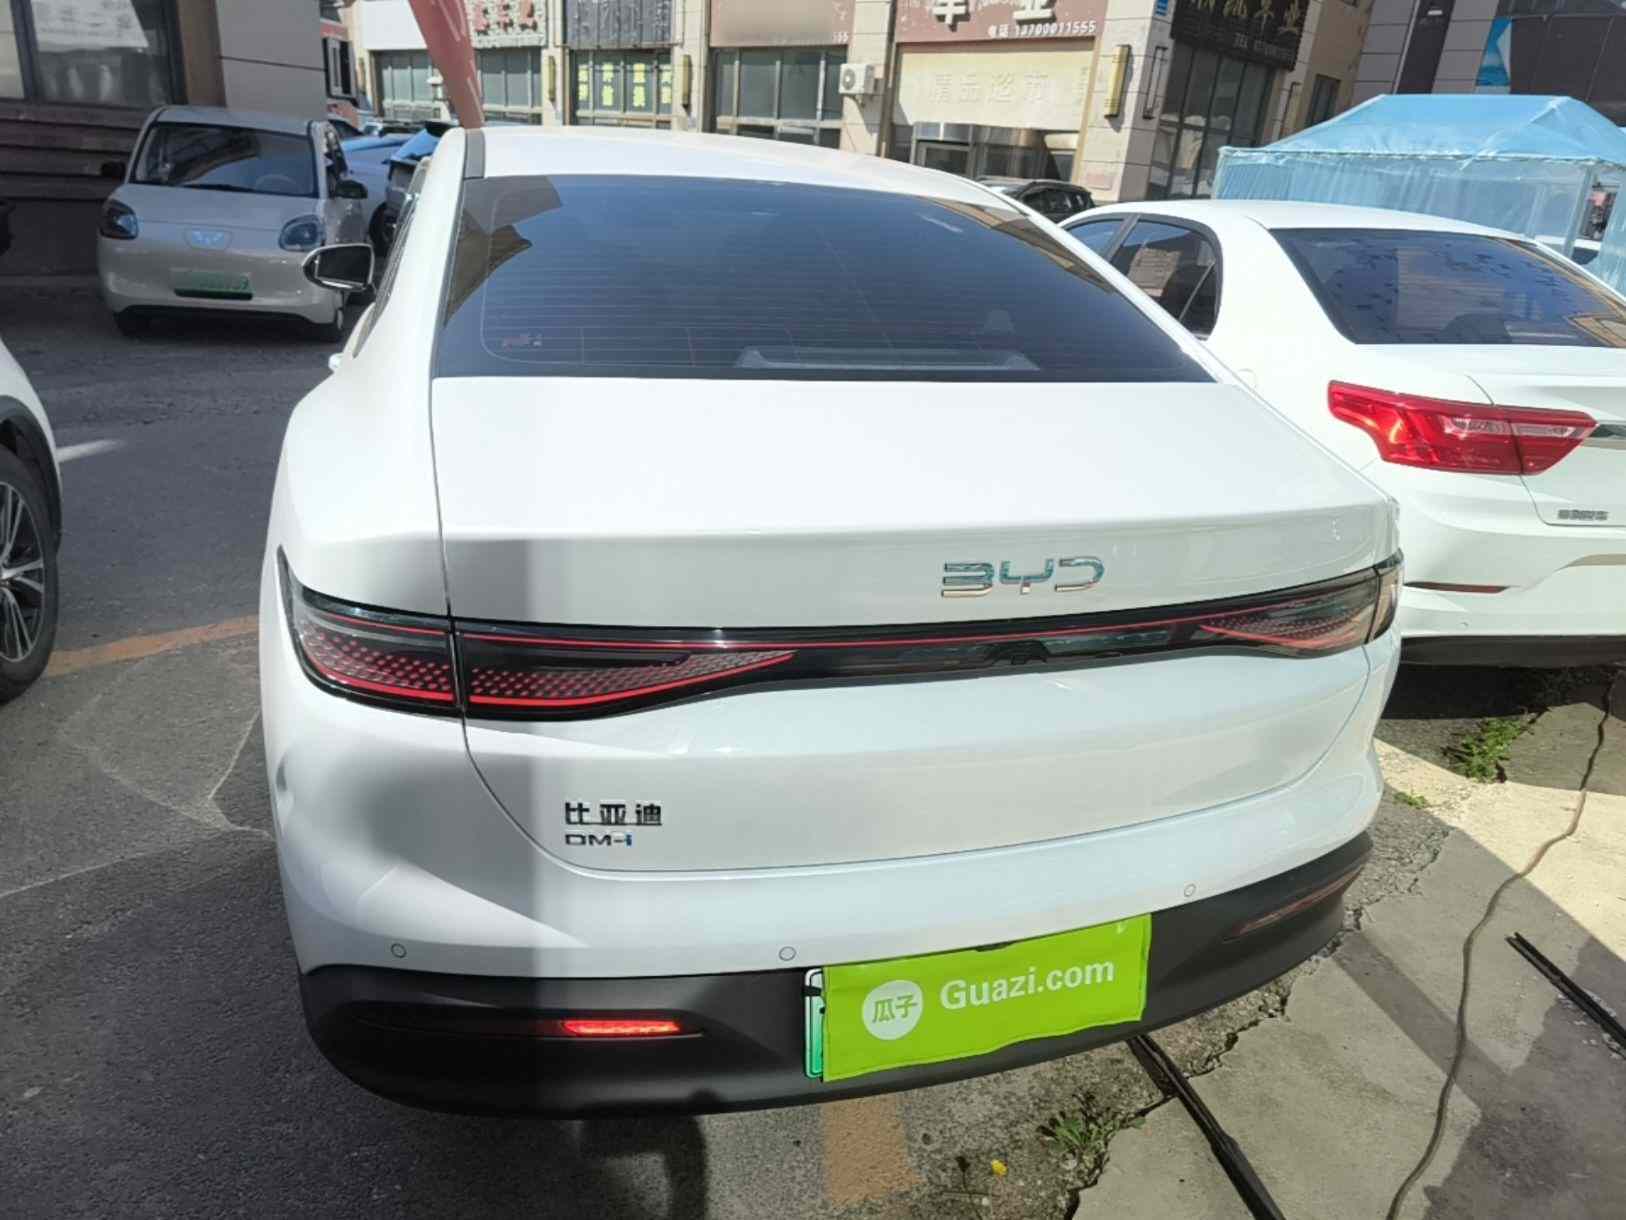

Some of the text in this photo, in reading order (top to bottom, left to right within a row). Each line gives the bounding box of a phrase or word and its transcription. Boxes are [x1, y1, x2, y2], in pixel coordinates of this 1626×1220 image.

[941, 556, 1104, 598] BYD
[564, 801, 662, 826] 比亚迪
[939, 959, 1115, 1010] Guazi.com
[871, 993, 919, 1024] 瓜子
